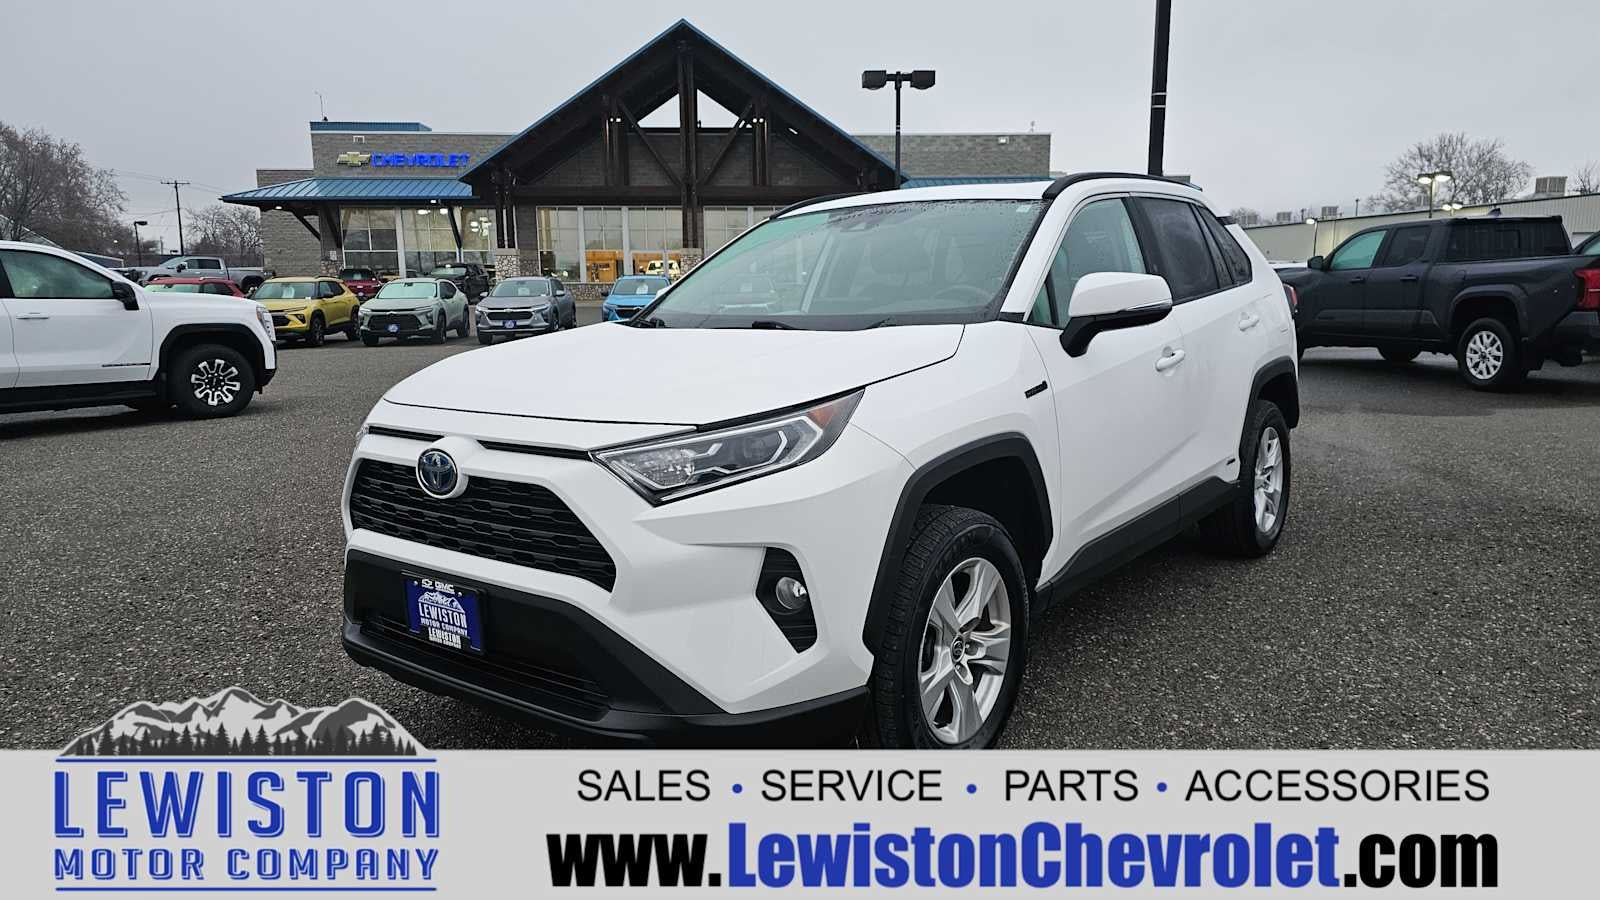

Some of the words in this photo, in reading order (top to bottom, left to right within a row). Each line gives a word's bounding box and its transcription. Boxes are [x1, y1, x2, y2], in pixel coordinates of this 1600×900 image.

[371, 152, 470, 167] CHEVROLET
[434, 581, 455, 594] GMC
[418, 602, 468, 628] LEWISTON
[420, 617, 441, 628] MOTOR
[428, 627, 461, 644] LEWISTON
